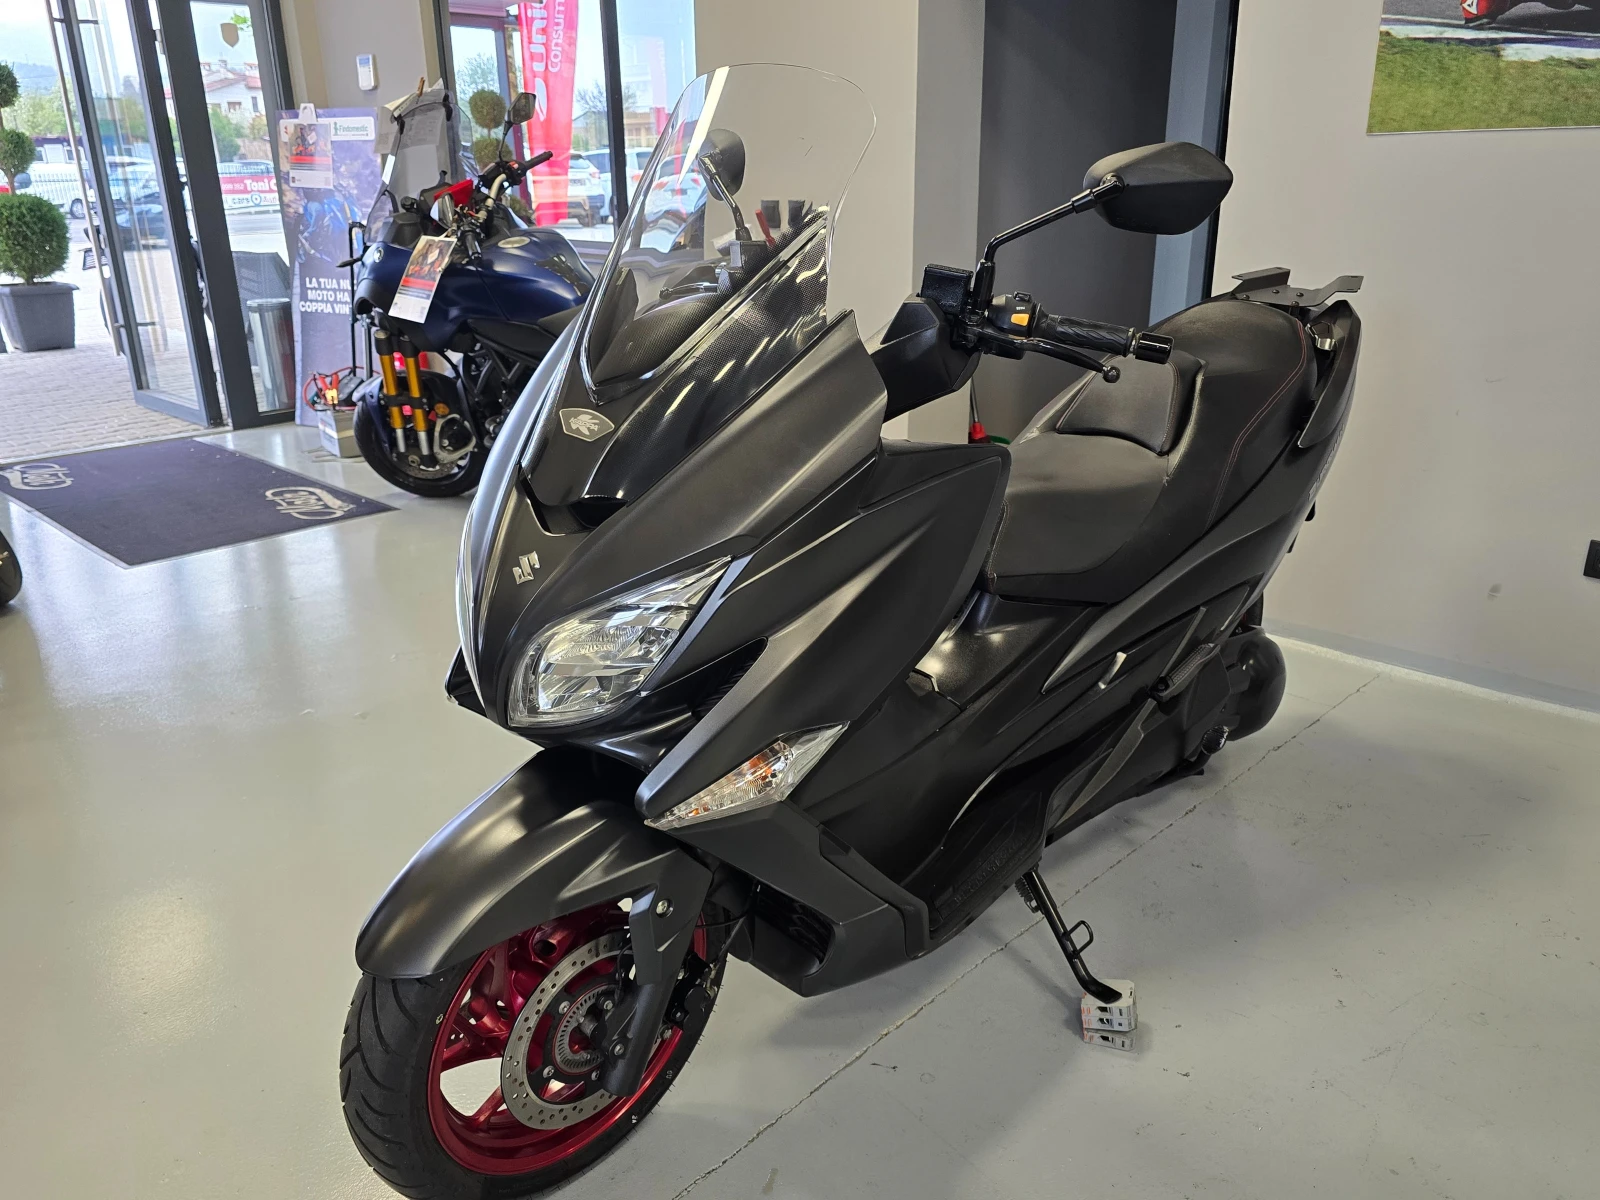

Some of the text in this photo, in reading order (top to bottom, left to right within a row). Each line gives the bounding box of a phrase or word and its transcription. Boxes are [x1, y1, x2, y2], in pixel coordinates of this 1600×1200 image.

[243, 178, 269, 191] Toni
[305, 276, 319, 289] LA
[319, 277, 339, 290] TUA
[307, 289, 350, 303] MOTO HA
[299, 301, 352, 315] COPPIA VIN
